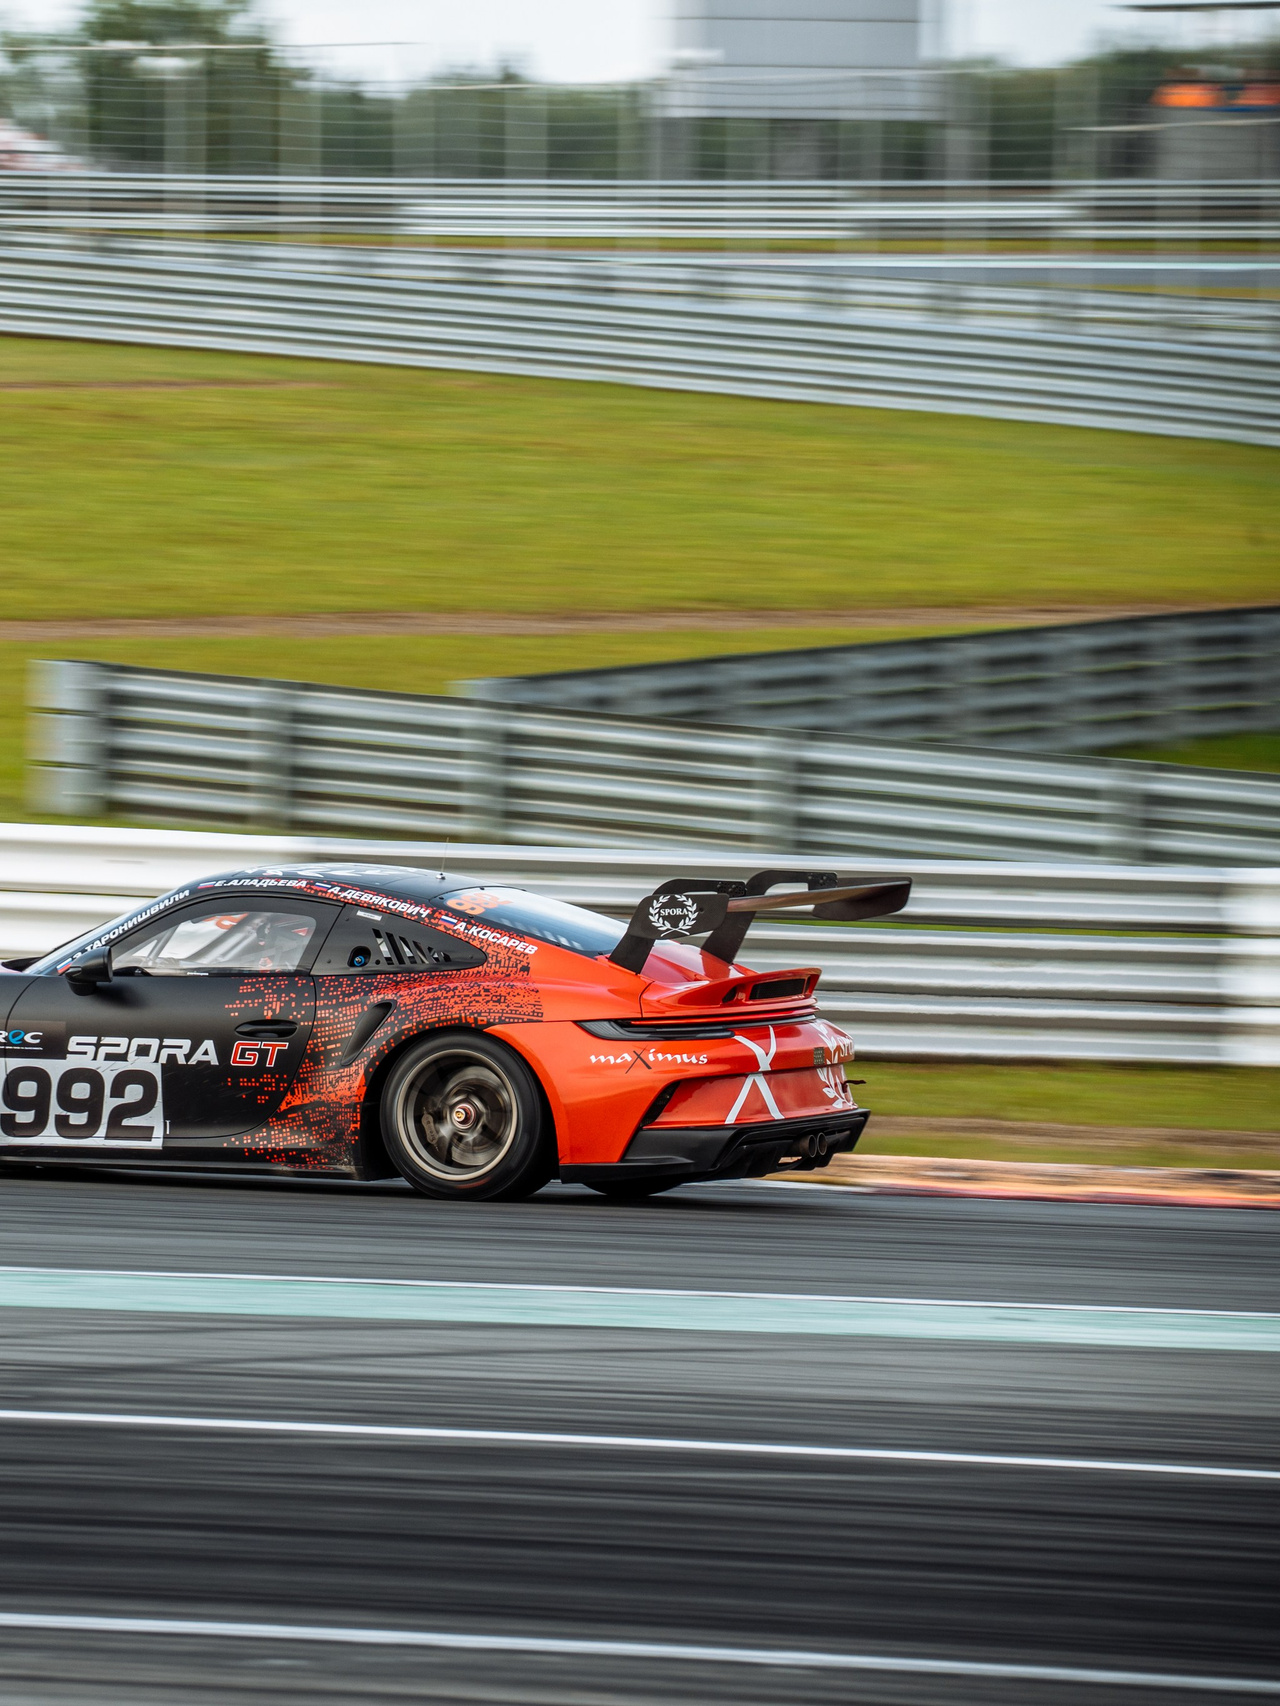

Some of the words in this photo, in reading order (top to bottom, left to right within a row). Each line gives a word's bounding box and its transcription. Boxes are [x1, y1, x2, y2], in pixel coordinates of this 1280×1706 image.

[214, 879, 308, 888] Е.АЛАДЬЕВА
[327, 886, 430, 918] А.ДЕВЯКОВИЧ
[660, 907, 688, 916] SPORA
[453, 921, 538, 954] А.КОСАРЕВ
[66, 1036, 219, 1065] SPORA
[230, 1041, 289, 1067] GT
[0, 1065, 158, 1142] 992
